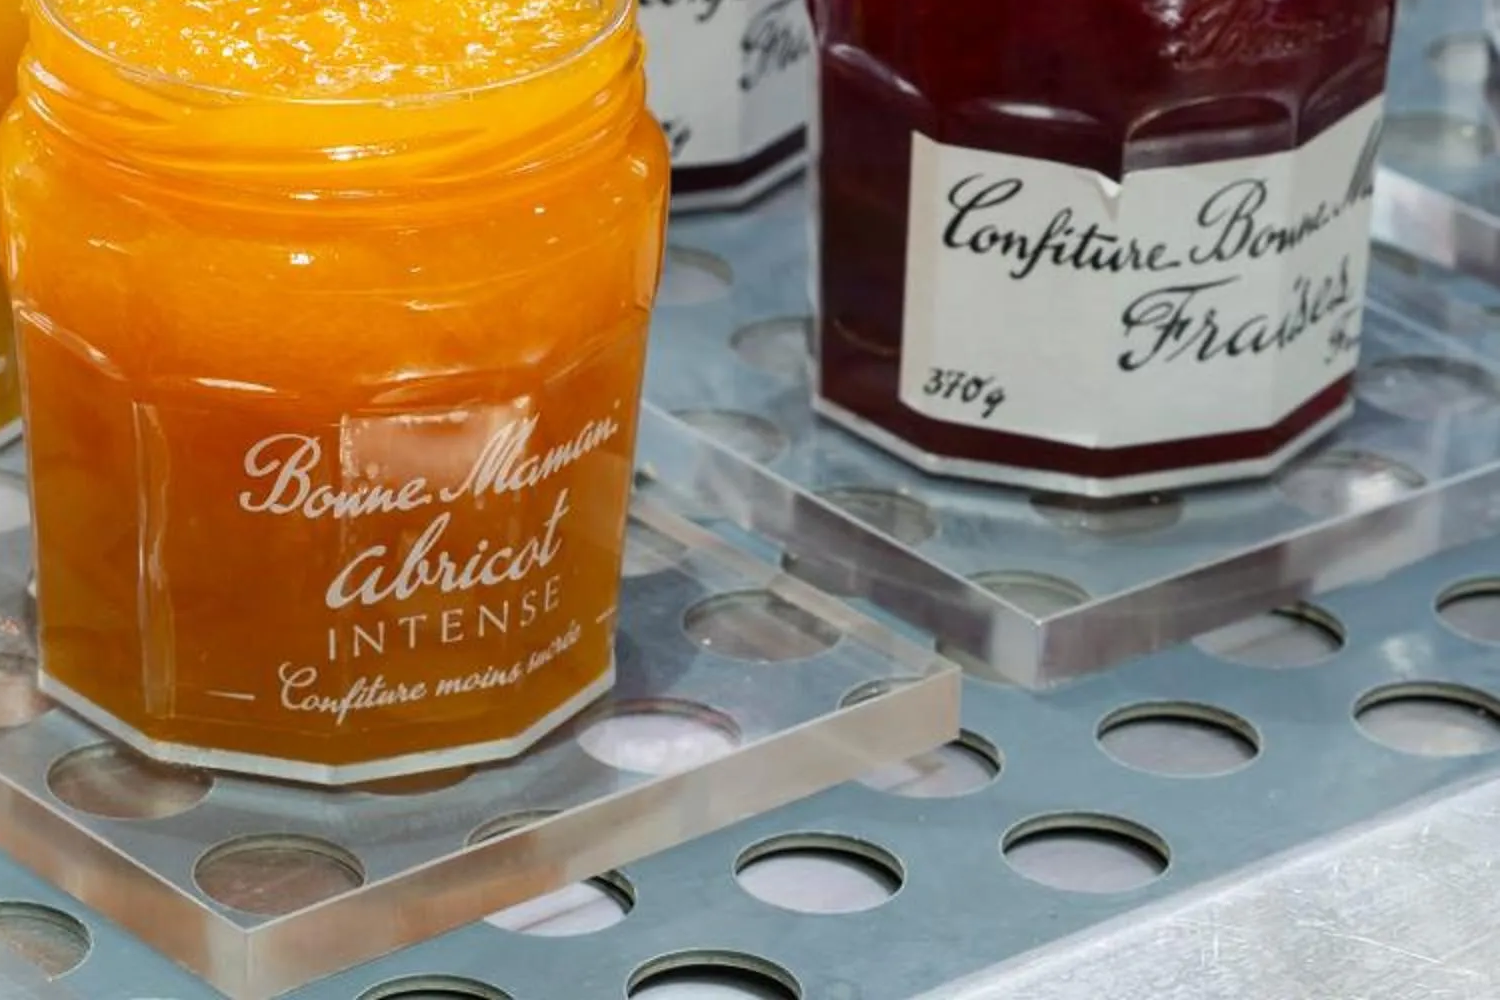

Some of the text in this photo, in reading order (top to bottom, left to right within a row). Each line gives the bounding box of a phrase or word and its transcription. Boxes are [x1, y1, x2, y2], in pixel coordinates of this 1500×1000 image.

[942, 174, 1180, 280] Confiture
[328, 576, 561, 661] INTENSE
[278, 661, 427, 725] Confiture
[435, 664, 525, 697] moins
